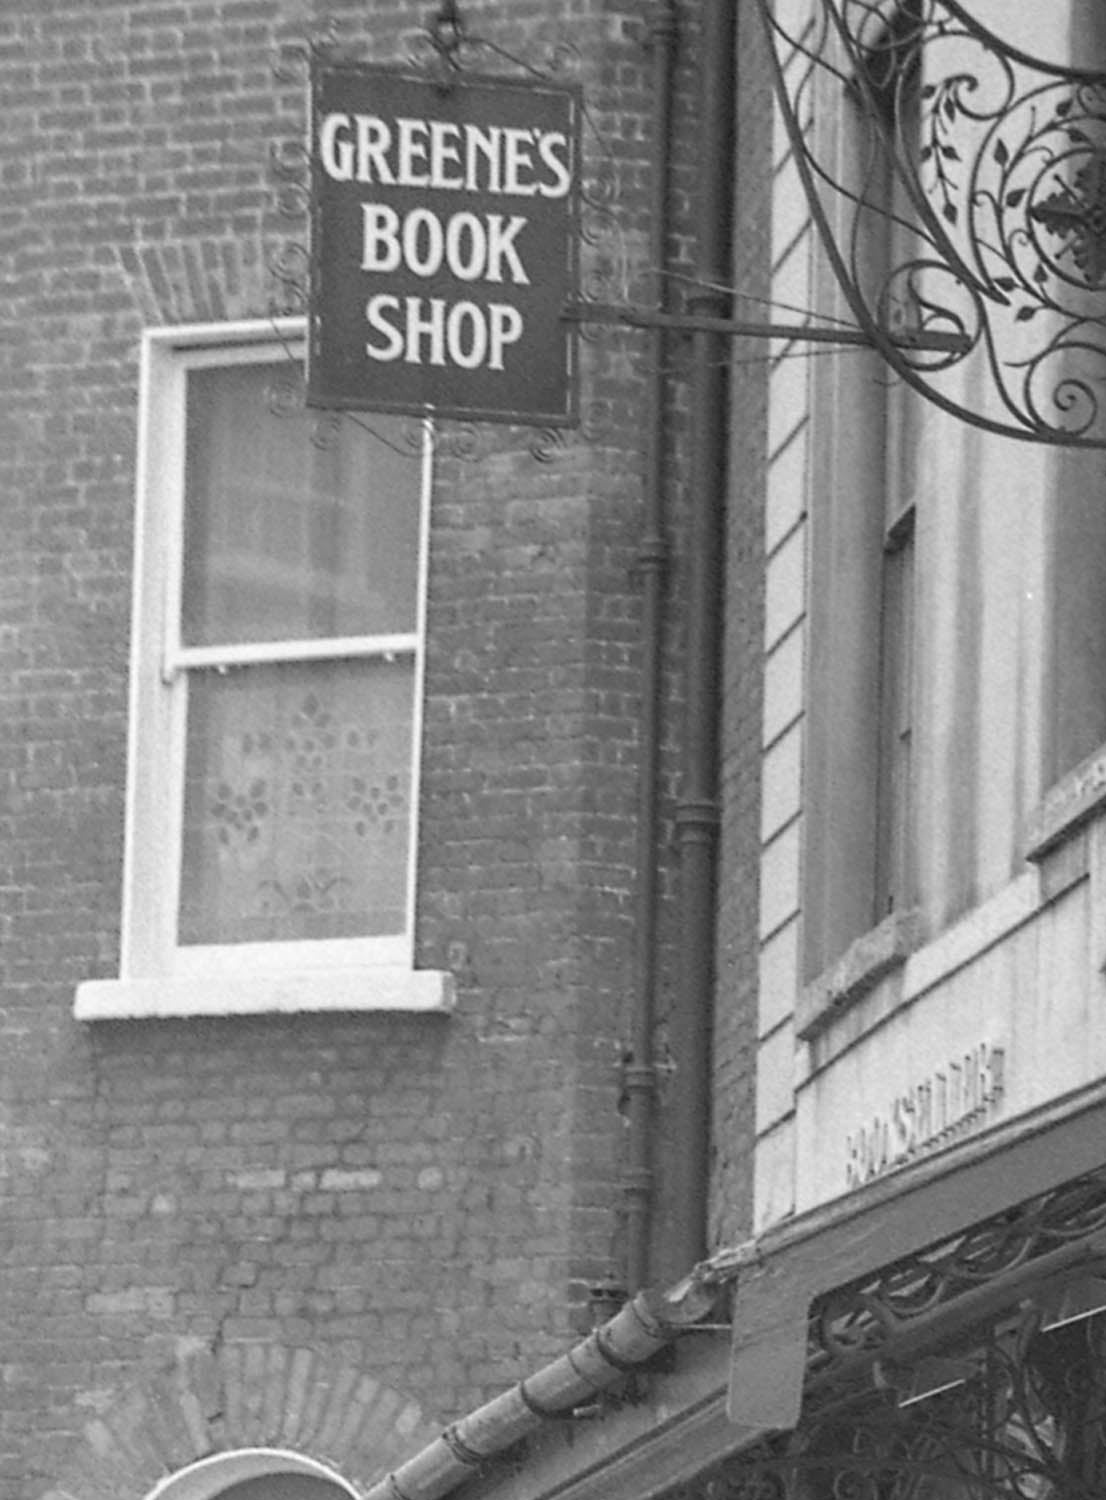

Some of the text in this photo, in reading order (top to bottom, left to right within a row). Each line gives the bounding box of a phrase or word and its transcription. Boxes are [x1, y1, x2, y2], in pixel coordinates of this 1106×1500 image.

[319, 113, 571, 198] GREENE'S
[361, 203, 530, 285] BOOK
[366, 294, 523, 370] SHOP
